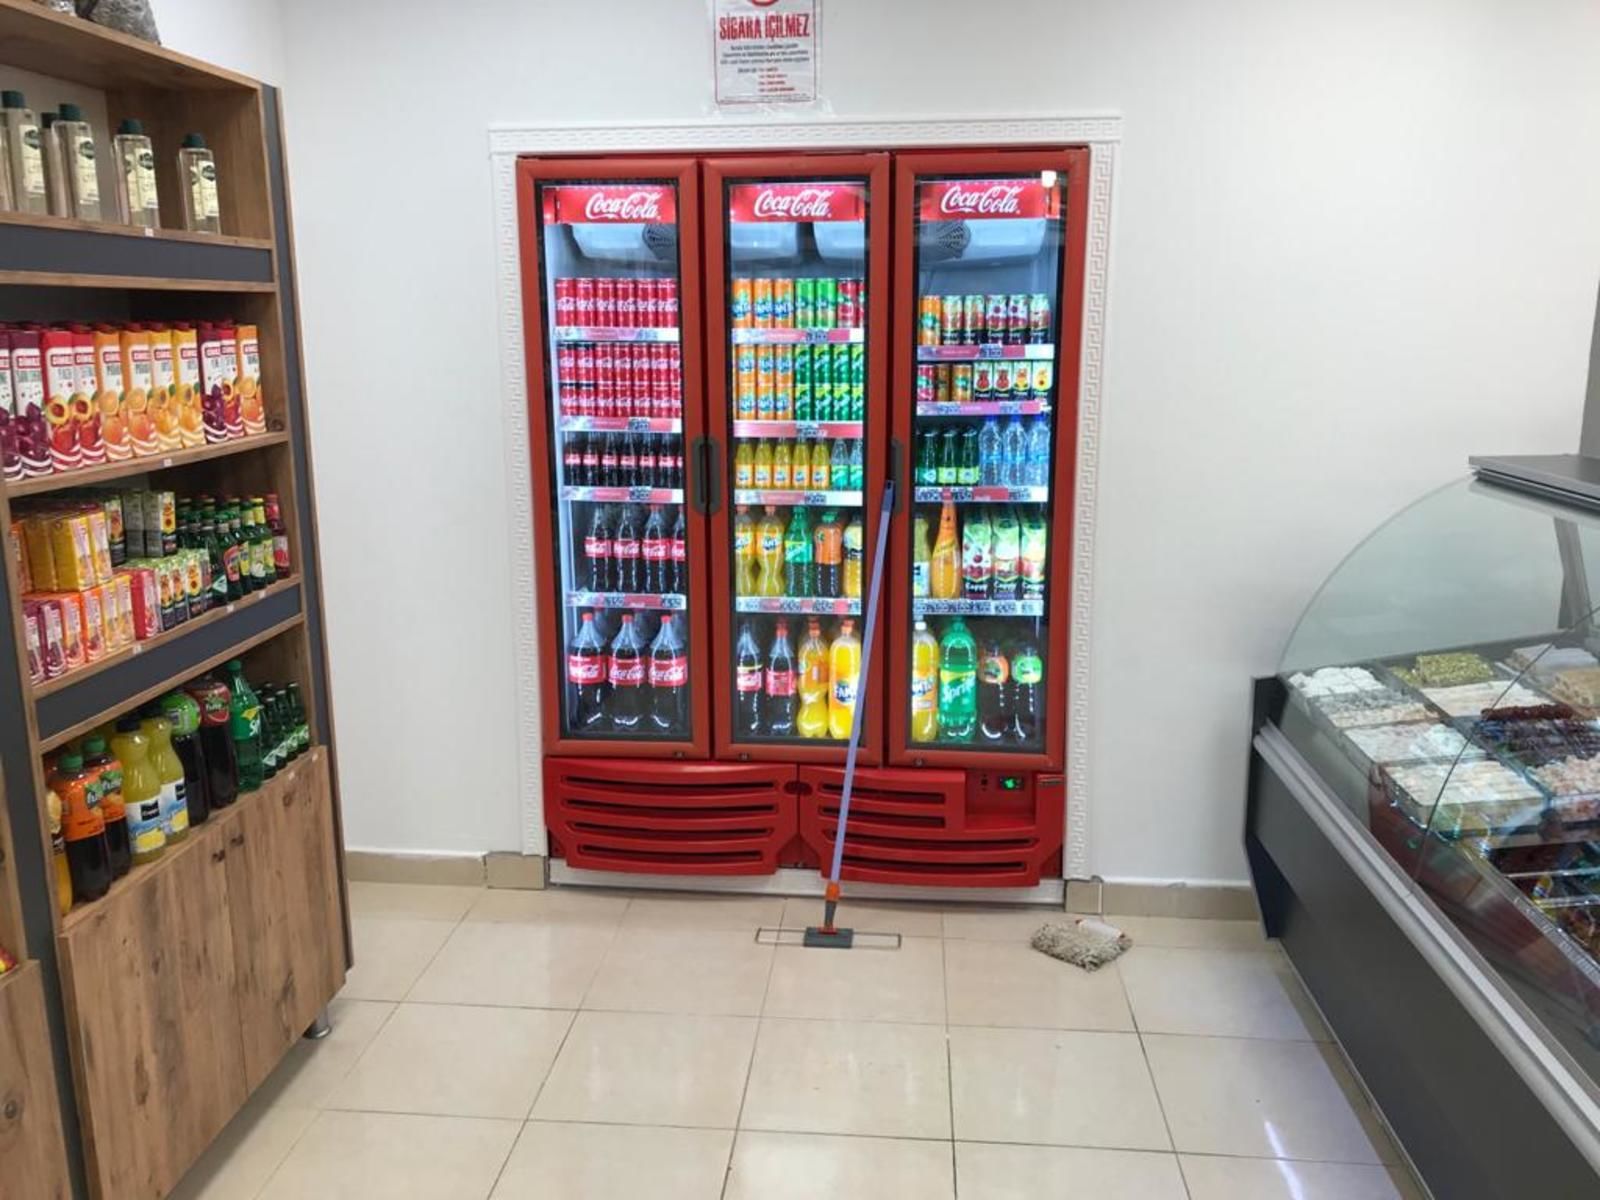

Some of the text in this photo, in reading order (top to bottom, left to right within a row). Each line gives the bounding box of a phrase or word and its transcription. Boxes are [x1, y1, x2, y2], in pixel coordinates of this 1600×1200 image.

[585, 191, 663, 219] Coca-Cola
[754, 189, 834, 217] Coca-Cola
[941, 185, 1024, 213] Coca-Cola
